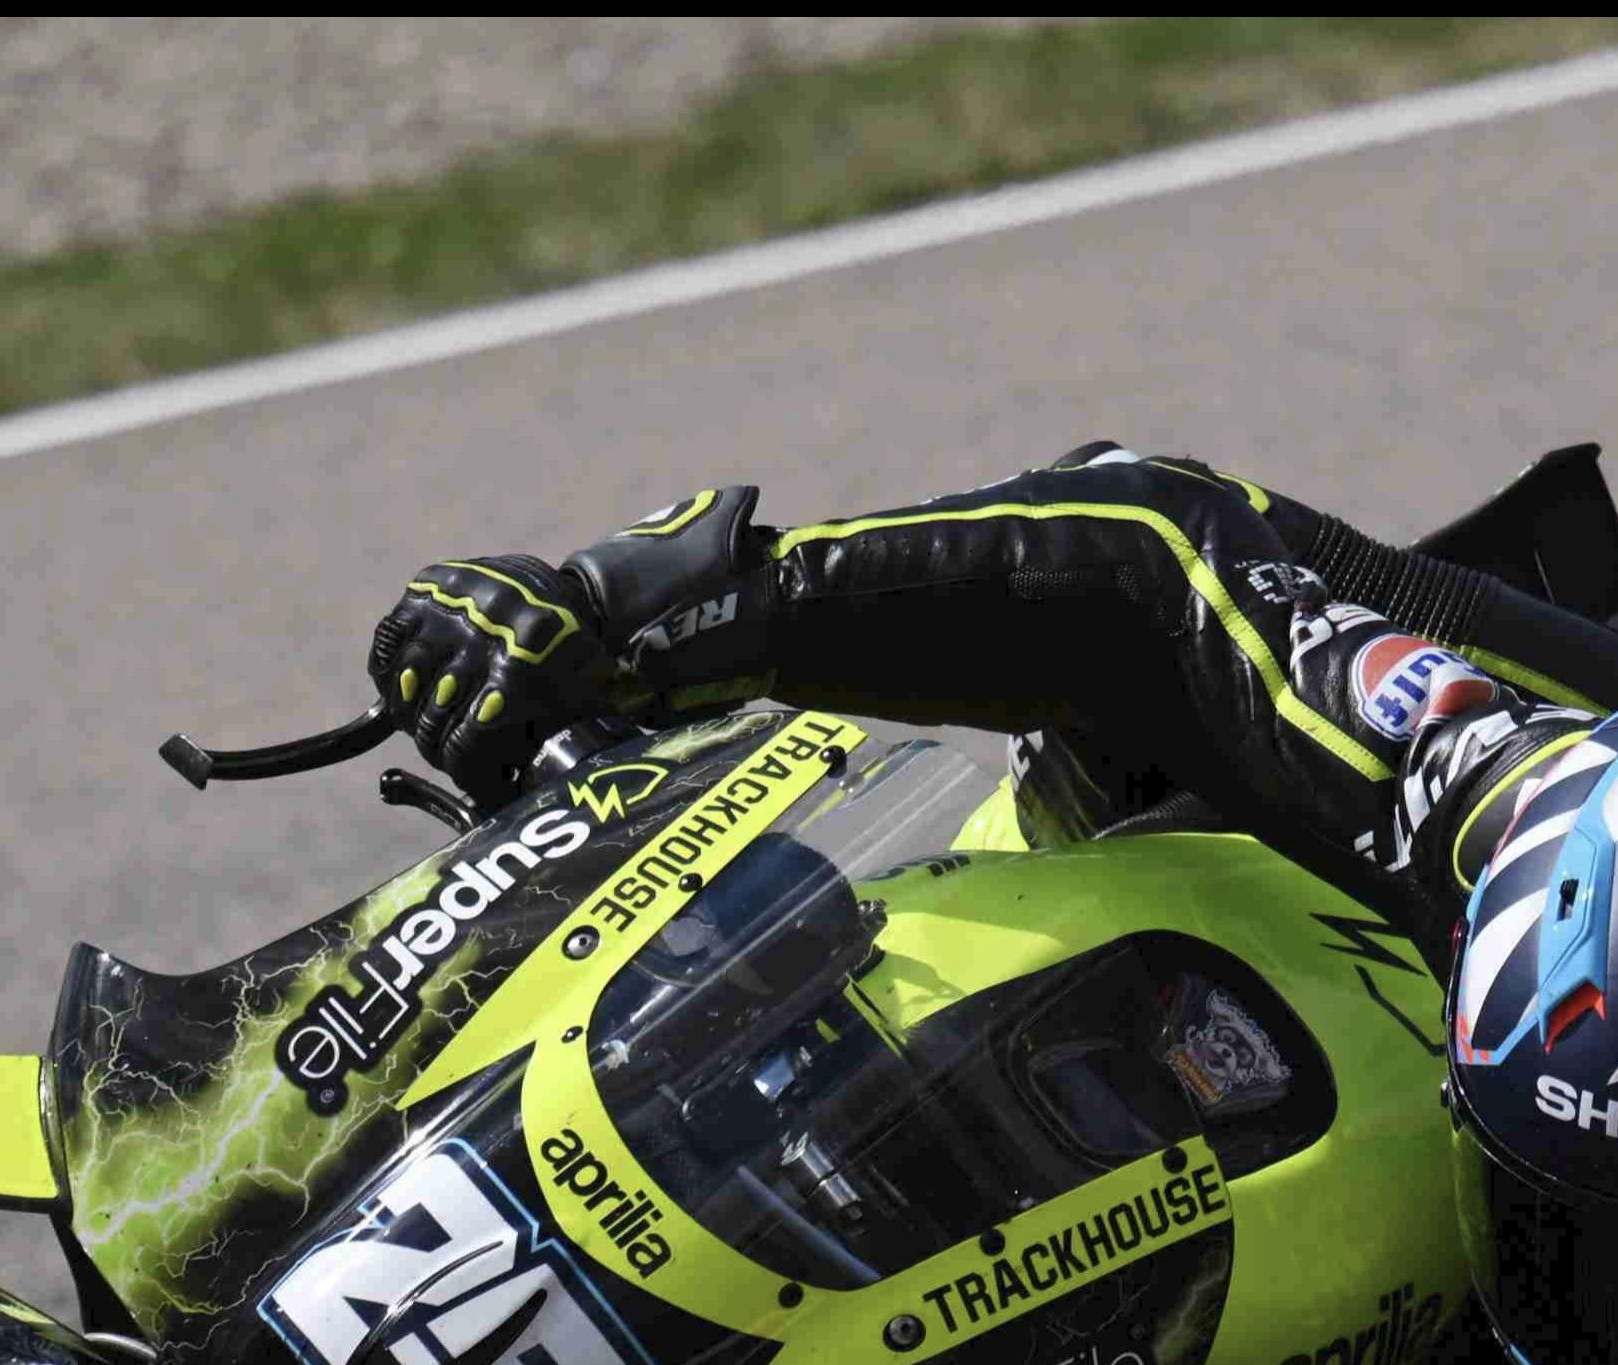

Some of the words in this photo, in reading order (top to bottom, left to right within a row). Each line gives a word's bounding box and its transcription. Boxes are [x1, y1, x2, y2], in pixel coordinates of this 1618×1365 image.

[590, 719, 846, 934] TRACKHOUSE
[287, 808, 591, 1080] SuperFile
[539, 1127, 674, 1280] aprilia
[922, 1163, 1229, 1337] TRACKHOUSE
